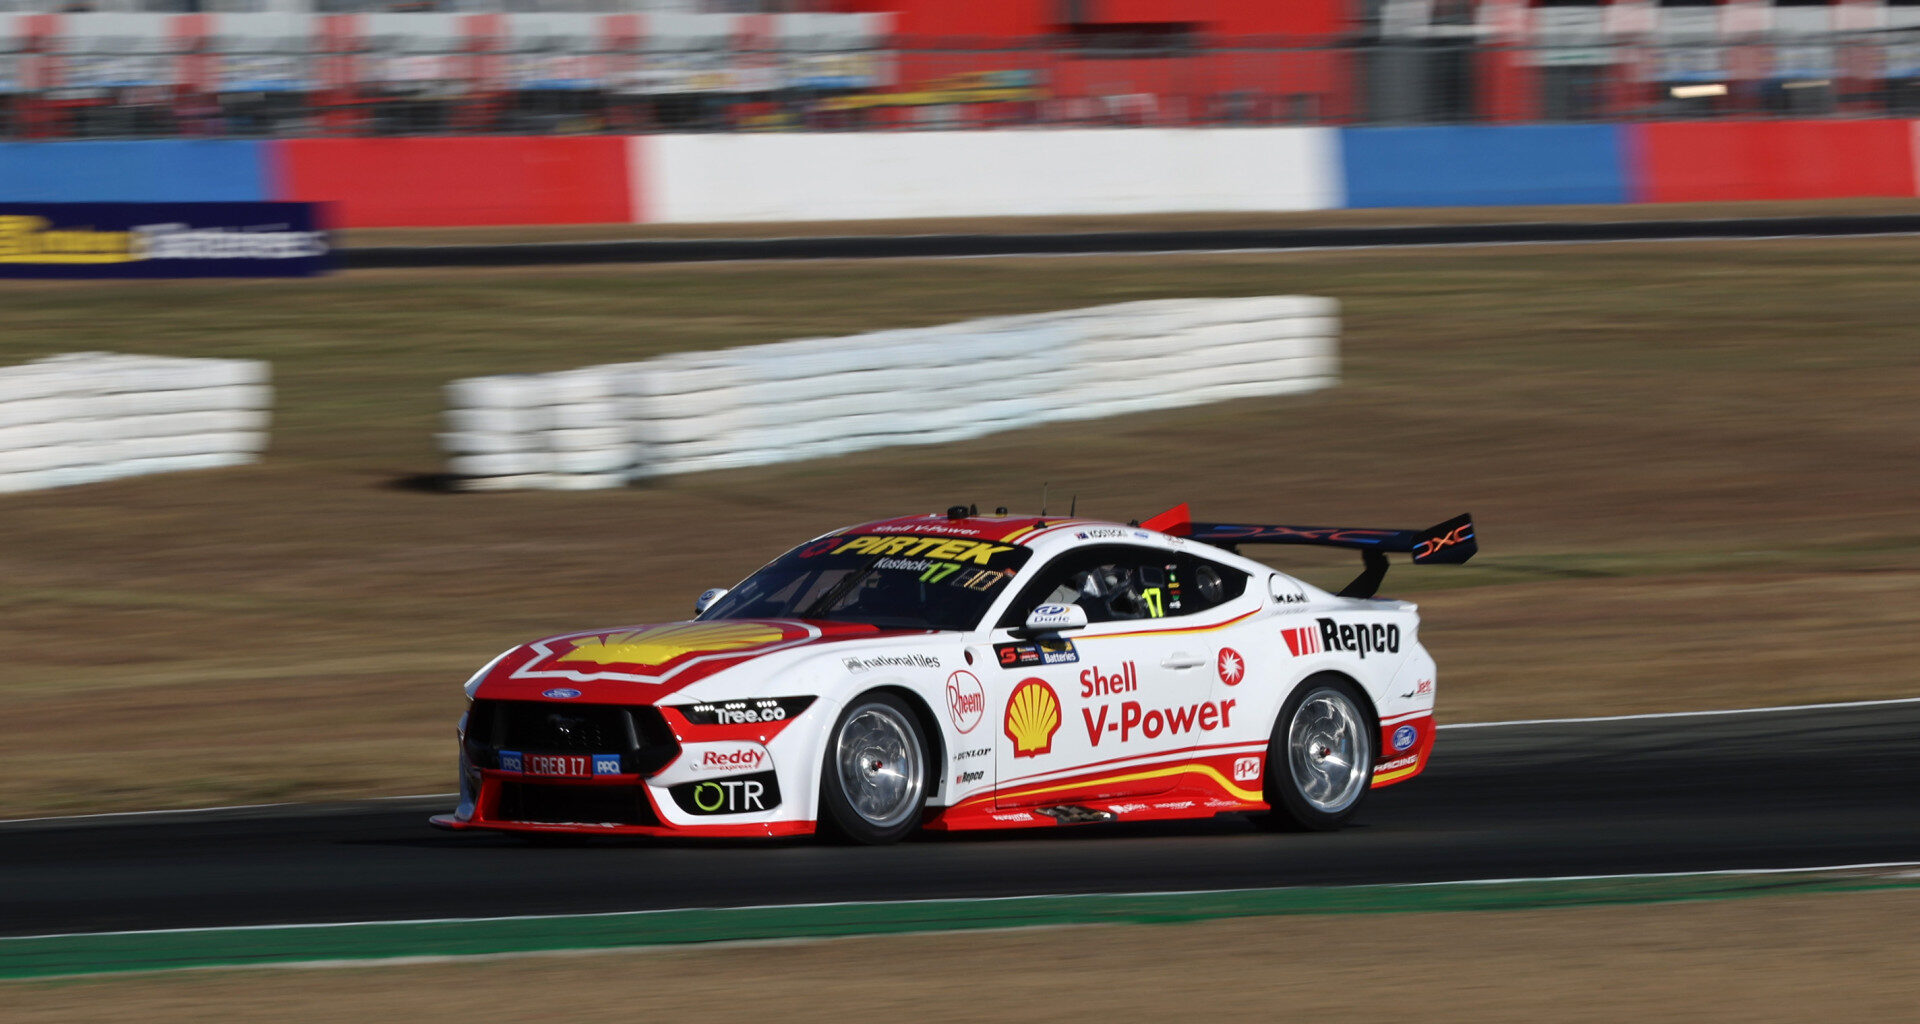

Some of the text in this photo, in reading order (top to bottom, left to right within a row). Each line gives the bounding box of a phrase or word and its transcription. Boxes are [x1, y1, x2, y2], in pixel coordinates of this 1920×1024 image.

[830, 536, 1014, 565] PIRTEK
[873, 557, 962, 583] Kostecki 17
[1142, 587, 1164, 618] 17
[1316, 617, 1399, 659] Repco
[1044, 652, 1076, 664] Batteries
[1080, 660, 1137, 698] Shell
[948, 672, 982, 723] Rheem
[715, 705, 785, 724] Tree.co
[1081, 698, 1237, 747] V-Power
[533, 757, 565, 774] CRE8
[703, 749, 765, 769] Reddy
[1374, 754, 1418, 772] RACING
[694, 781, 764, 811] OTR
